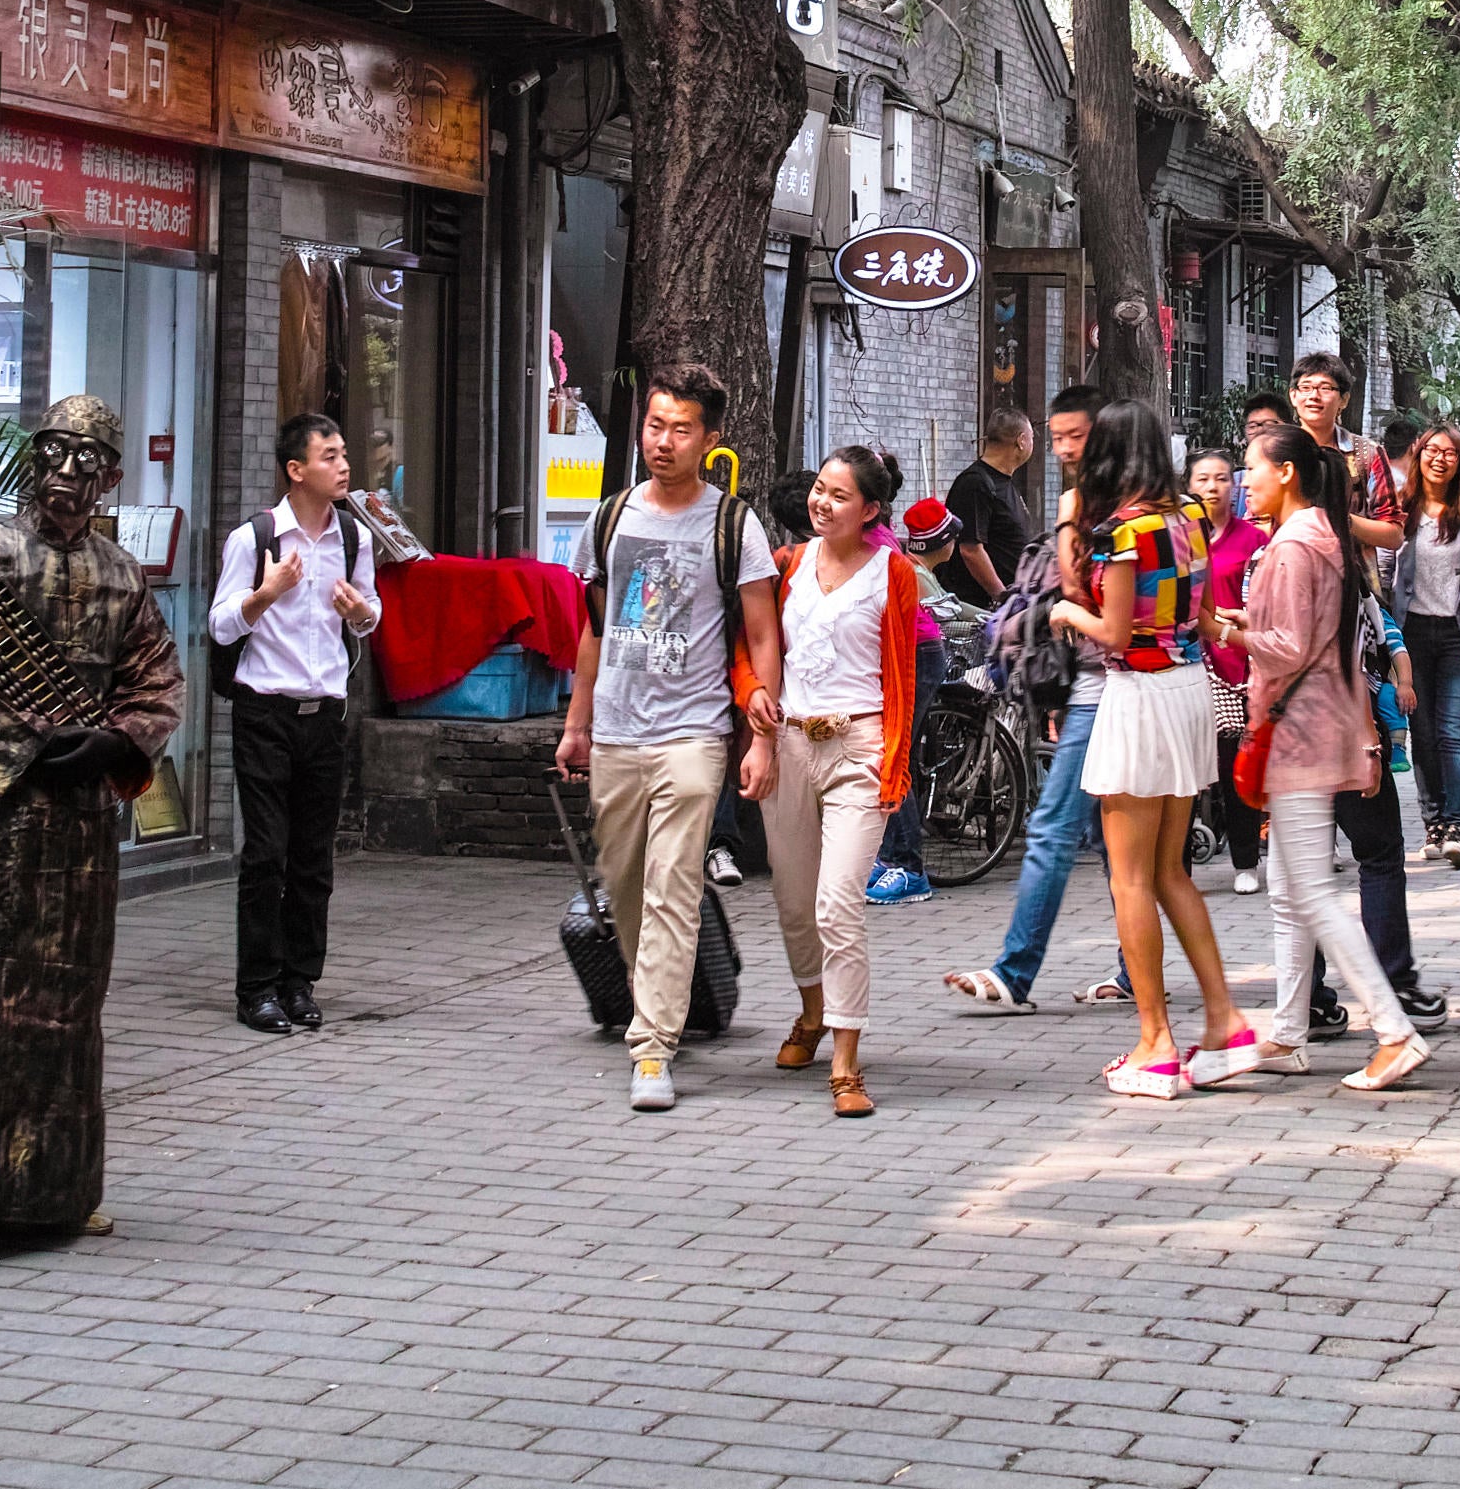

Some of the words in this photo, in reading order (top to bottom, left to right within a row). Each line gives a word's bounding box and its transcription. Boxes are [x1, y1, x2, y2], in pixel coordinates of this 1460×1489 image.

[84, 187, 191, 237] 新款上市全场8.8折
